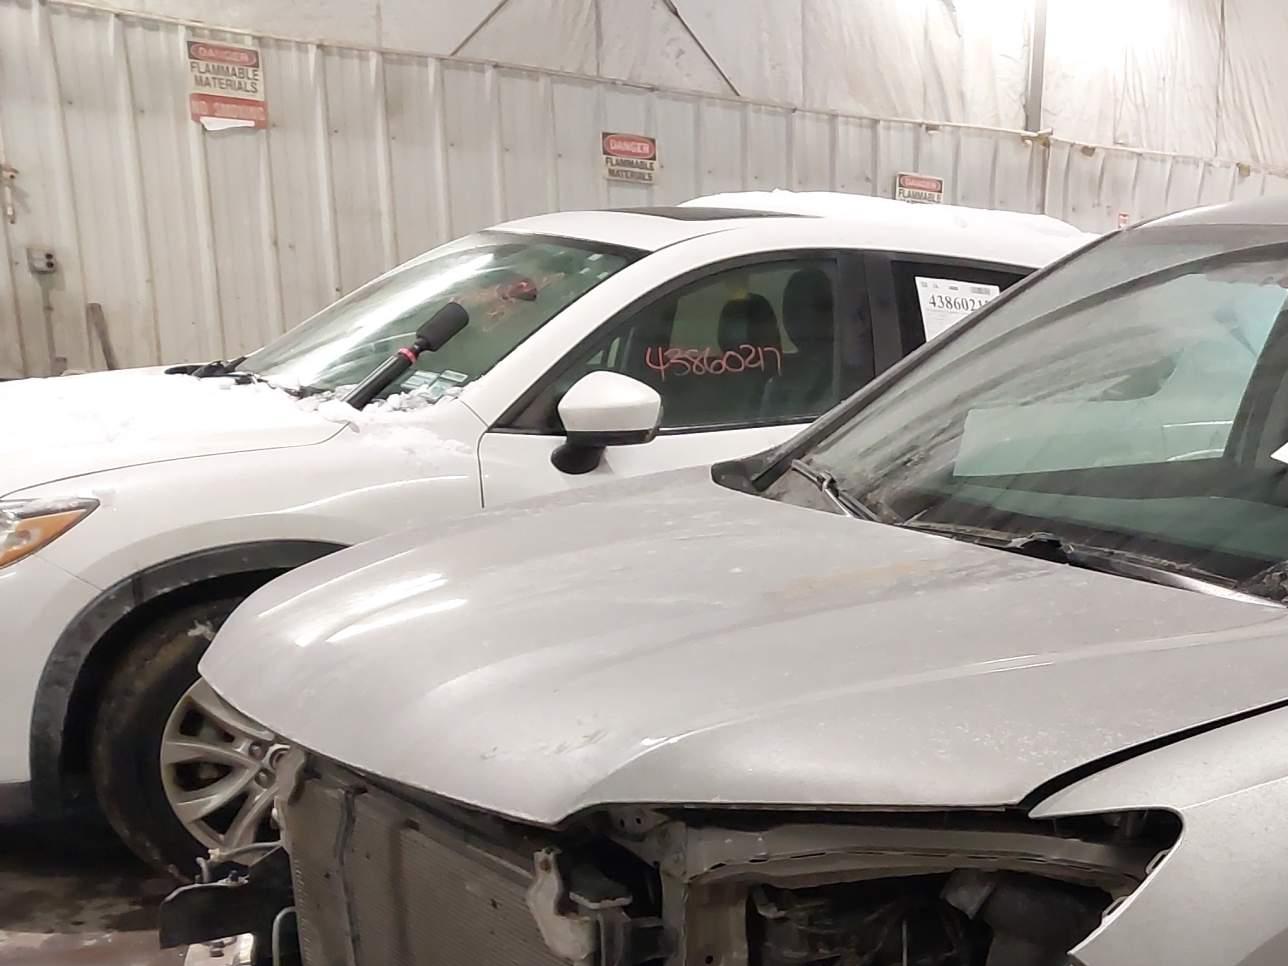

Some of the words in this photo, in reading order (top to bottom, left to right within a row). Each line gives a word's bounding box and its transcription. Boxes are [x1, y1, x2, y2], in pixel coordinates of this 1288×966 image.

[190, 61, 260, 82] FLAMMABLE
[194, 75, 259, 94] MATERIALS
[609, 138, 650, 154] DANGER
[605, 156, 655, 171] FLAMMABLE
[608, 168, 653, 182] MATERIALS
[898, 188, 942, 202] FLAMMABLE
[646, 344, 782, 381] 43860217
